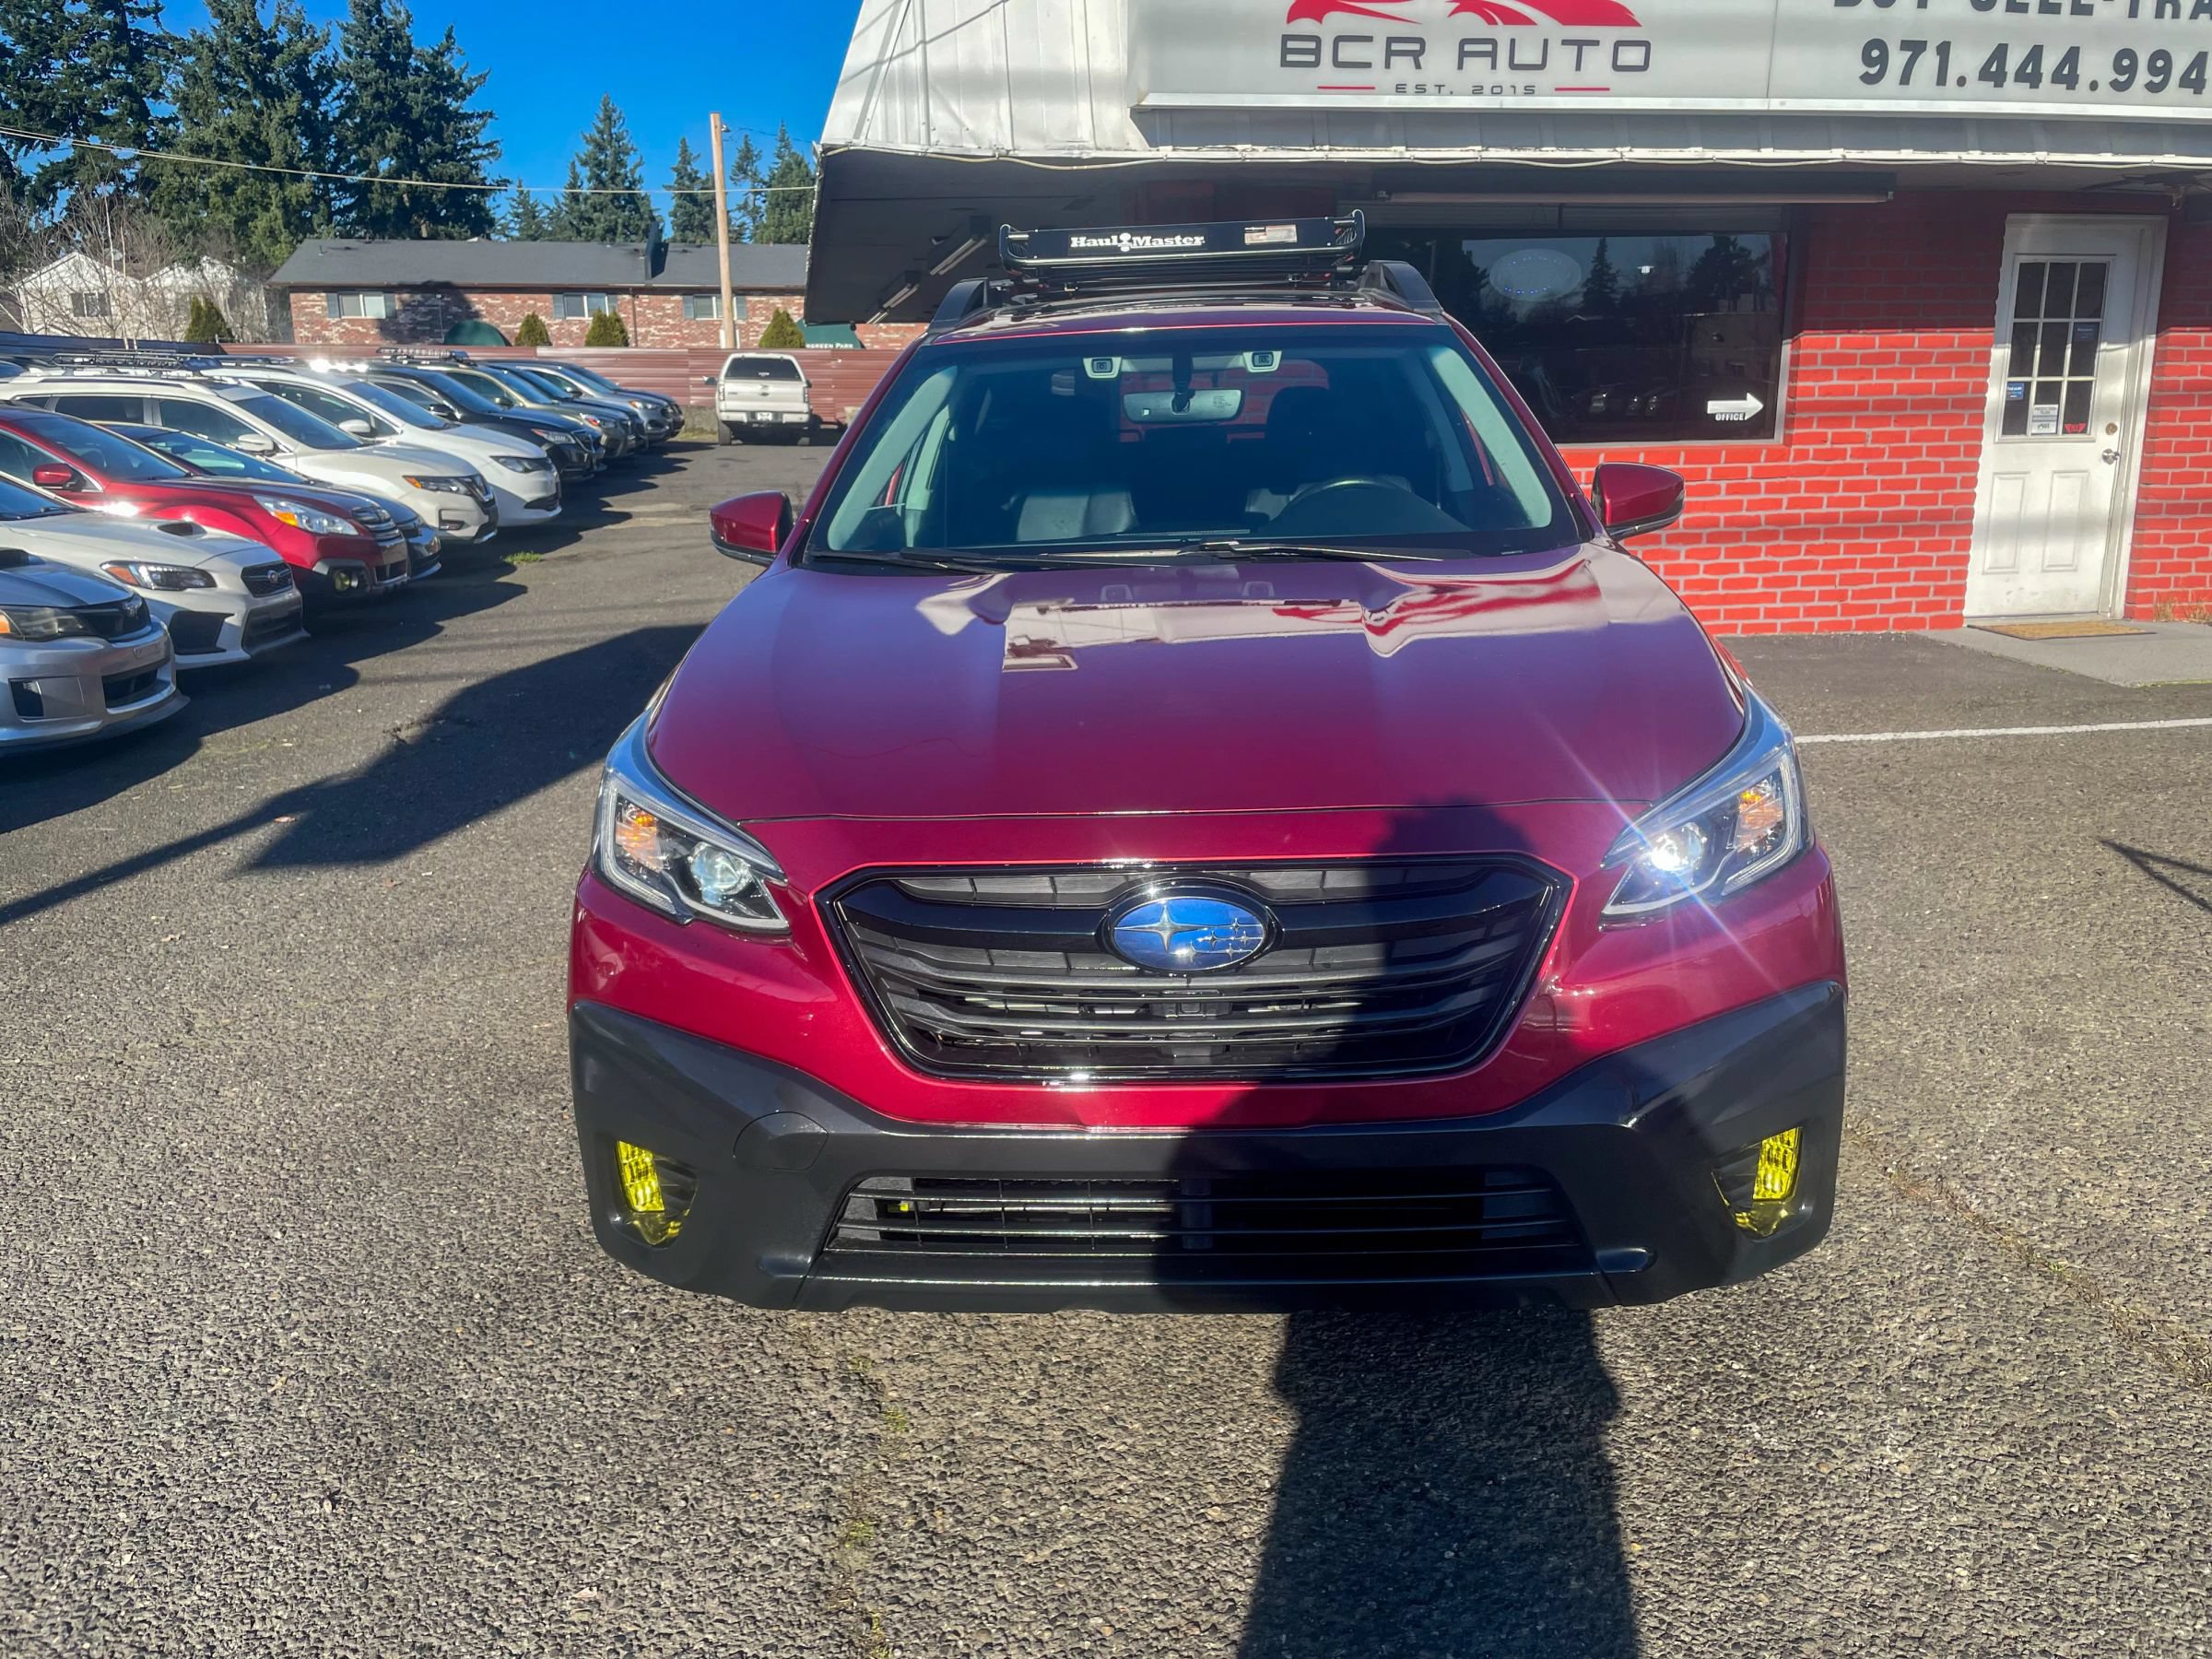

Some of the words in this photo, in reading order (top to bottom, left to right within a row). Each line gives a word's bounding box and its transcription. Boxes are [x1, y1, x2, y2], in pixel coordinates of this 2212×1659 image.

[1279, 33, 1427, 70] BCR
[1456, 37, 1652, 73] AUTO
[1858, 37, 2210, 96] 971.444.994
[1394, 83, 1455, 95] EST.
[1471, 84, 1536, 96] 2015
[1070, 235, 1118, 248] Haul
[1714, 412, 1744, 421] OFFICE
